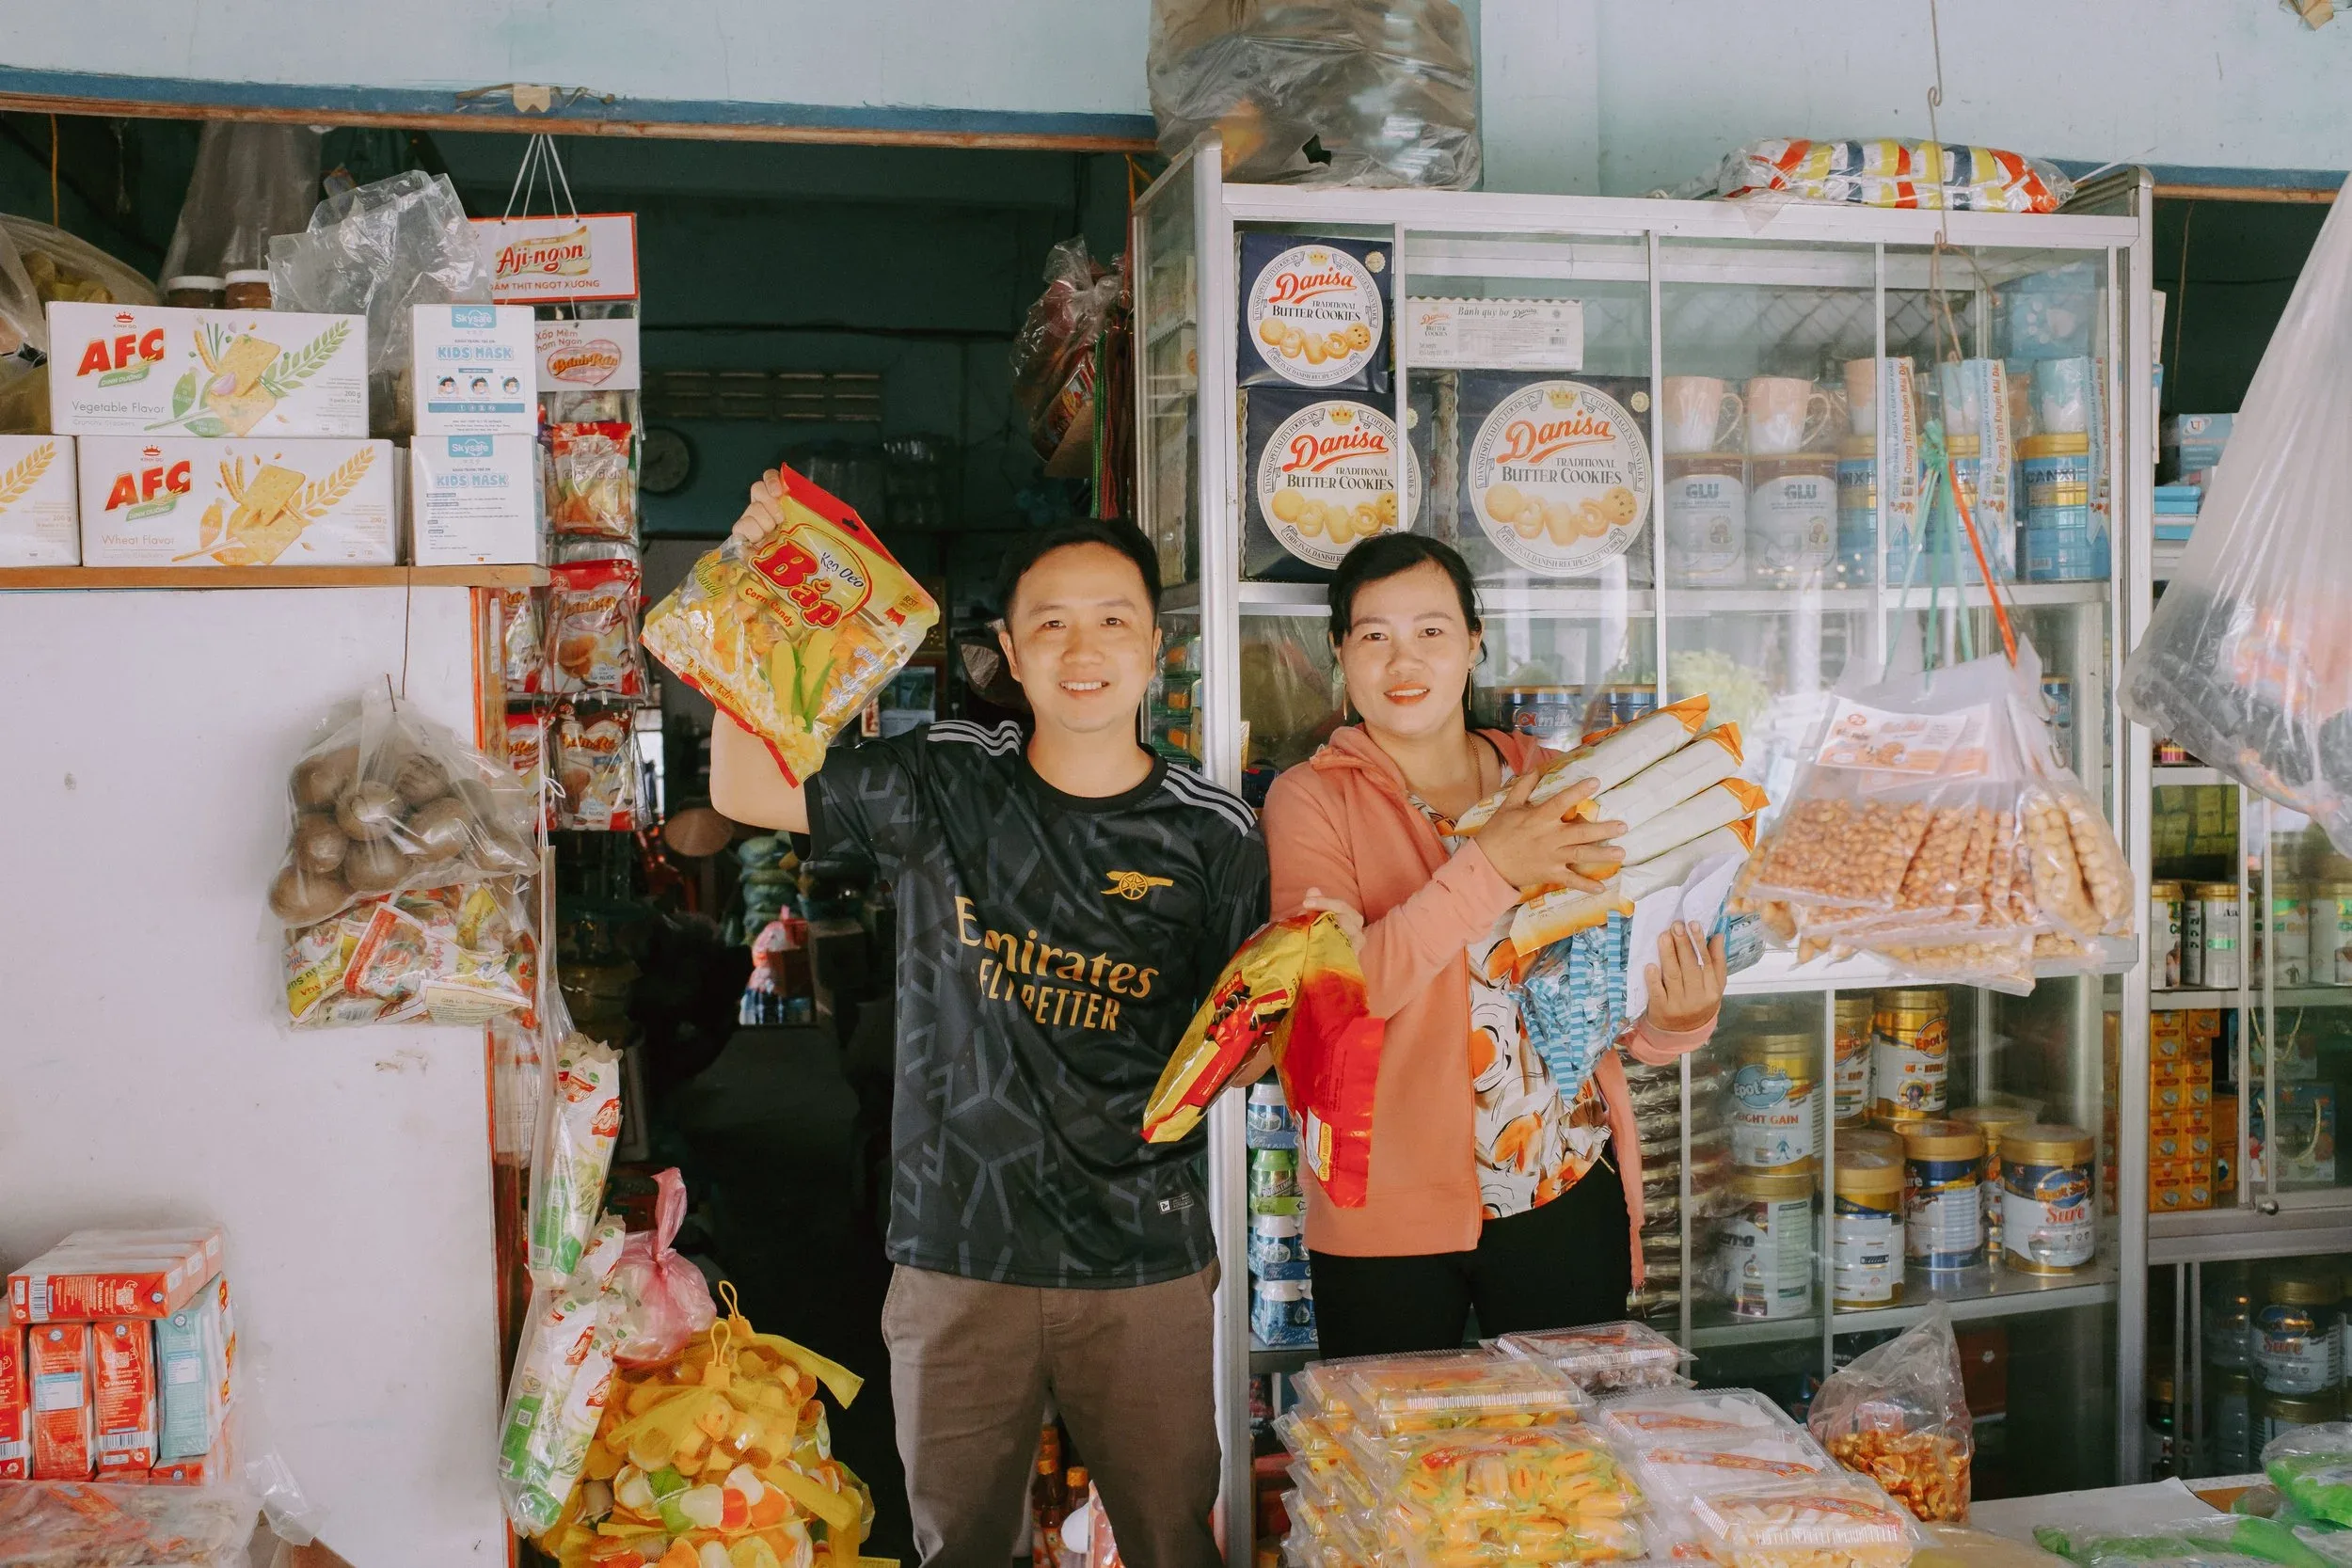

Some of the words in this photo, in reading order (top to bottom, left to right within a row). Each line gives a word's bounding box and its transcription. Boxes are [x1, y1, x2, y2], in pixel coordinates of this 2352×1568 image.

[497, 244, 583, 274] Aji-ngon
[1268, 267, 1357, 305] Danisa
[1311, 300, 1356, 309] TRADITIONAL
[455, 313, 492, 325] Skysafe
[1273, 305, 1313, 319] BUTTER
[1315, 308, 1360, 322] COOKIES
[77, 328, 165, 376] AFC
[437, 347, 471, 358] KIDS
[475, 347, 512, 358] MASK
[72, 401, 128, 414] Vegetable
[132, 403, 165, 414] Flavor
[1496, 409, 1616, 466] Danisa
[452, 443, 489, 454] Skysafe
[1281, 425, 1390, 473] Danisa
[1556, 458, 1616, 468] TRADITIONAL
[1335, 467, 1390, 477] TRADITIONAL
[1502, 466, 1557, 483] BUTTER
[1560, 467, 1622, 485] COOKIES
[104, 460, 191, 512] AFC
[437, 475, 468, 486] KIDS
[471, 475, 507, 486] MASK
[1287, 474, 1336, 489] BUTTER
[1339, 476, 1394, 491] COOKIES
[1685, 483, 1720, 499] GLU
[1784, 483, 1818, 499] GLU
[102, 534, 138, 546] Wheat
[142, 534, 175, 546] Flavor
[744, 587, 767, 605] Corn
[769, 596, 795, 627] Candy
[902, 594, 919, 608] BEST
[954, 895, 1159, 999] Emirates
[1021, 984, 1121, 1032] BETTER
[1770, 1115, 1799, 1124] GAIN
[2046, 1206, 2086, 1224] Sure
[110, 1378, 138, 1388] VINAMILK
